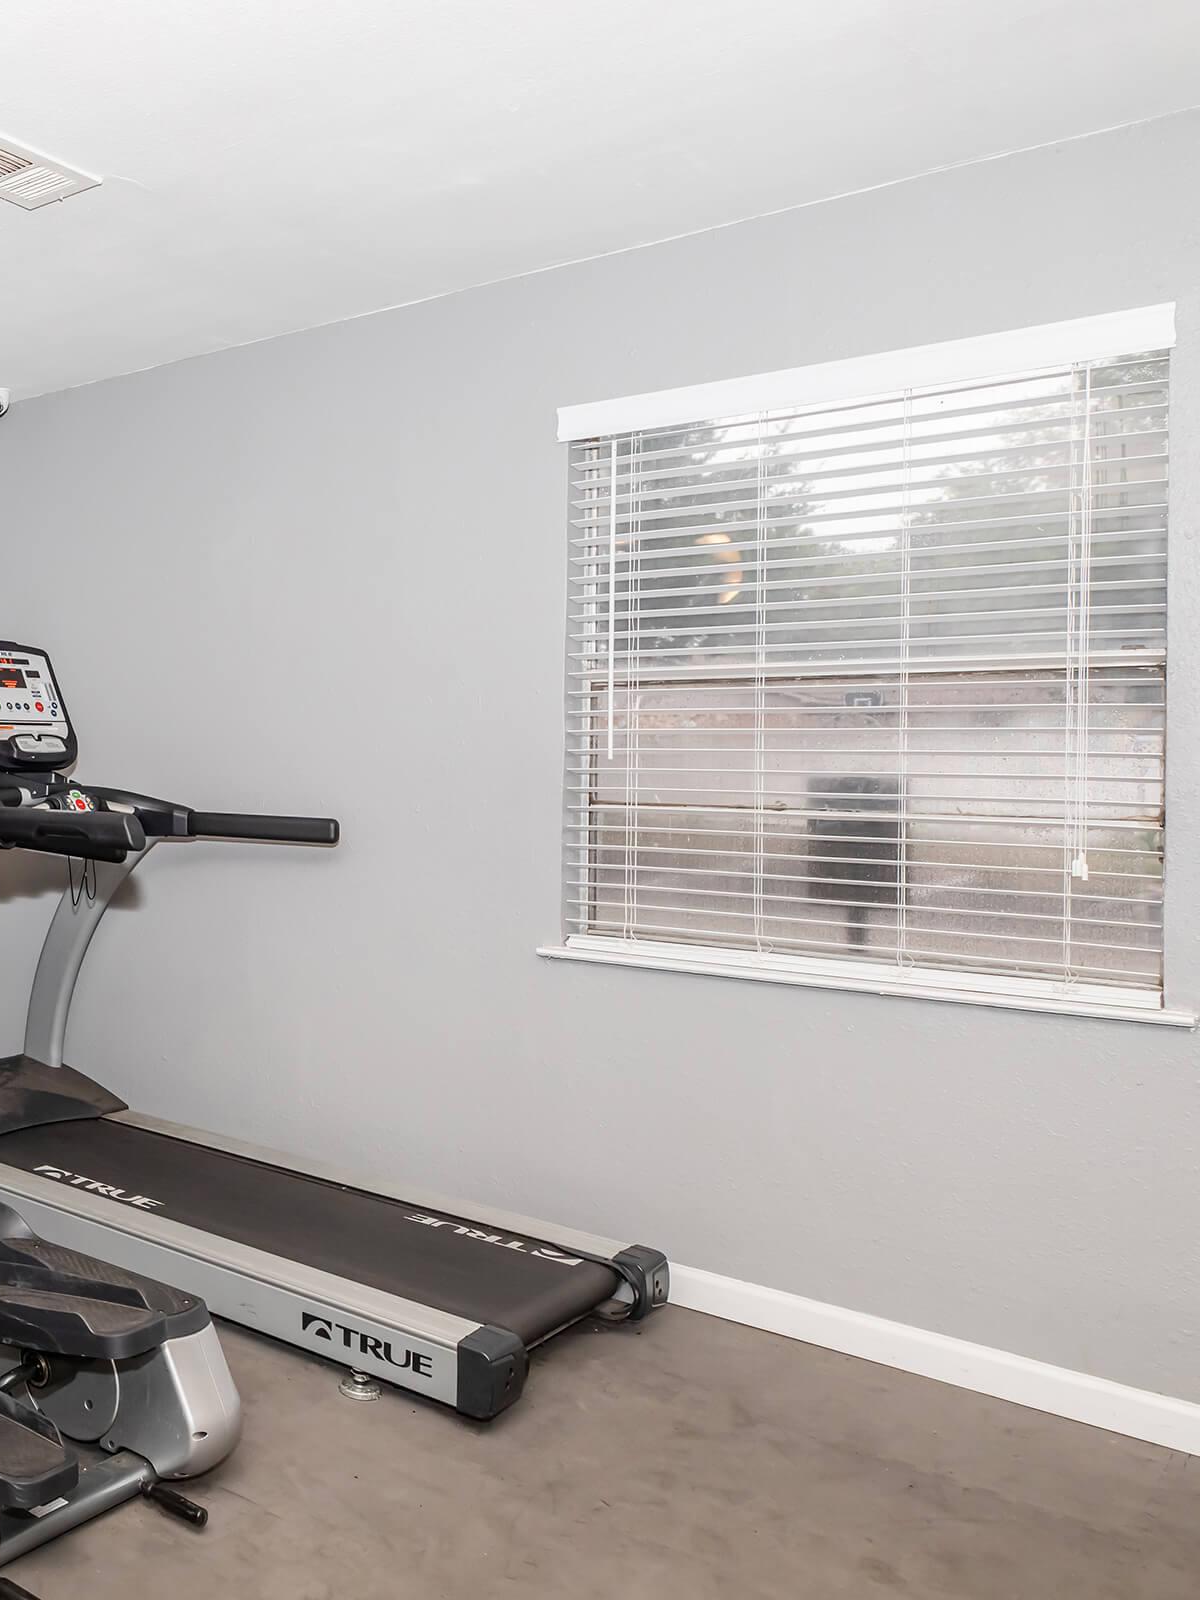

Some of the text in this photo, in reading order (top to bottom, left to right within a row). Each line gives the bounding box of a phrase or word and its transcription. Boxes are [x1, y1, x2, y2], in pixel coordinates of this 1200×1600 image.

[70, 1174, 165, 1209] TRUE
[403, 1213, 528, 1253] TRUE
[334, 1323, 433, 1378] TRUE
